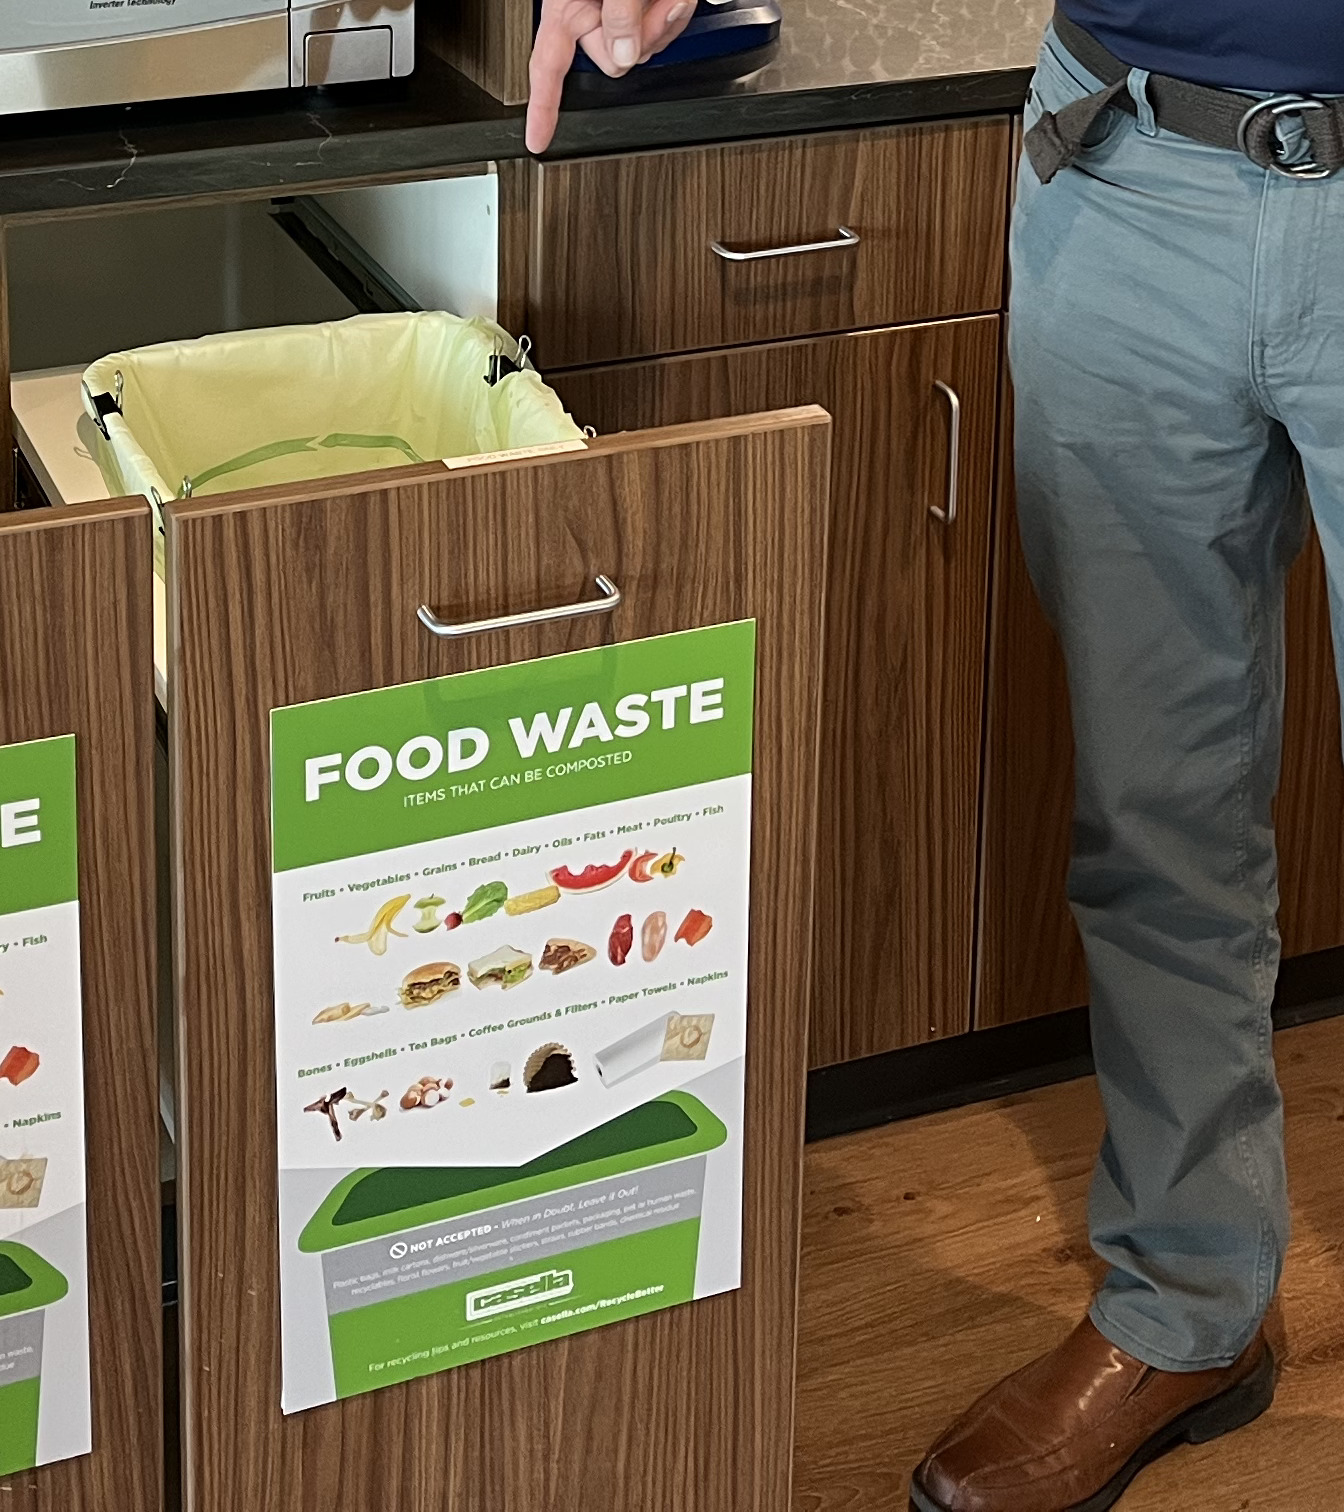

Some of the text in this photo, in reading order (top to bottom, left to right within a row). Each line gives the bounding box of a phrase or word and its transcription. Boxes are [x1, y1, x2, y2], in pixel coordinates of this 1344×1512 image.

[89, 0, 124, 9] Inverter
[304, 677, 725, 802] FOOD WASTE
[403, 750, 632, 808] ITEMS THAT CAN BE COMPOSTED
[302, 805, 724, 902] Fruits Vegetables Grains Bread Dairy Oils Fats Meat Poultry Fish
[22, 934, 48, 948] Fish
[297, 1063, 333, 1079] Bones
[343, 1047, 397, 1068] Eggshells
[408, 1041, 428, 1052] Tea
[430, 1033, 457, 1048] Bags
[468, 1022, 505, 1038] Coffee
[507, 1012, 552, 1028] Grounds
[564, 1000, 598, 1016] Filters
[608, 991, 640, 1005] Paper
[641, 982, 677, 997] Towels
[687, 970, 729, 986] Napkins
[12, 1110, 62, 1129] Napkins
[410, 1239, 434, 1254] NOT
[435, 1224, 492, 1247] ACCEPTED
[501, 1215, 531, 1229] When
[578, 1195, 606, 1210] Leave
[368, 1362, 385, 1373] For
[386, 1349, 430, 1368] recycling
[451, 1338, 470, 1349] and
[519, 1319, 538, 1331] visit
[540, 1284, 664, 1325] casella.com/RecycleBetter
